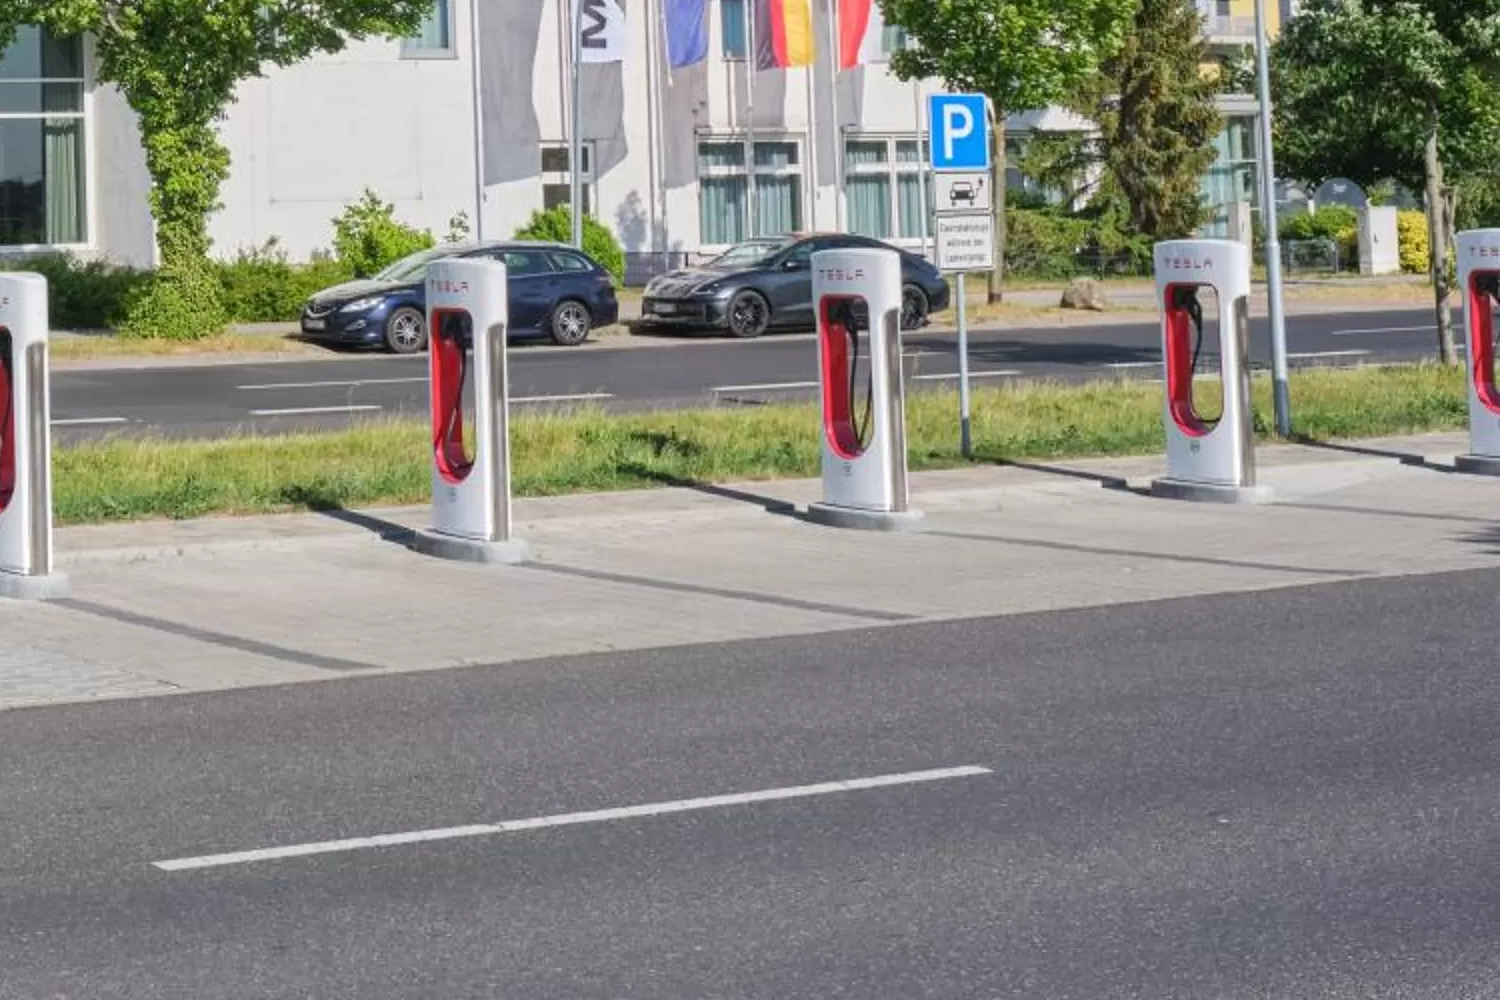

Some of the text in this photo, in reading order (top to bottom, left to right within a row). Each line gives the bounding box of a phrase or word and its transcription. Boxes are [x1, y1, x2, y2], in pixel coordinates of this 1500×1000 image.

[942, 103, 974, 160] P
[1163, 257, 1213, 269] TESLA
[819, 268, 865, 281] TESLA
